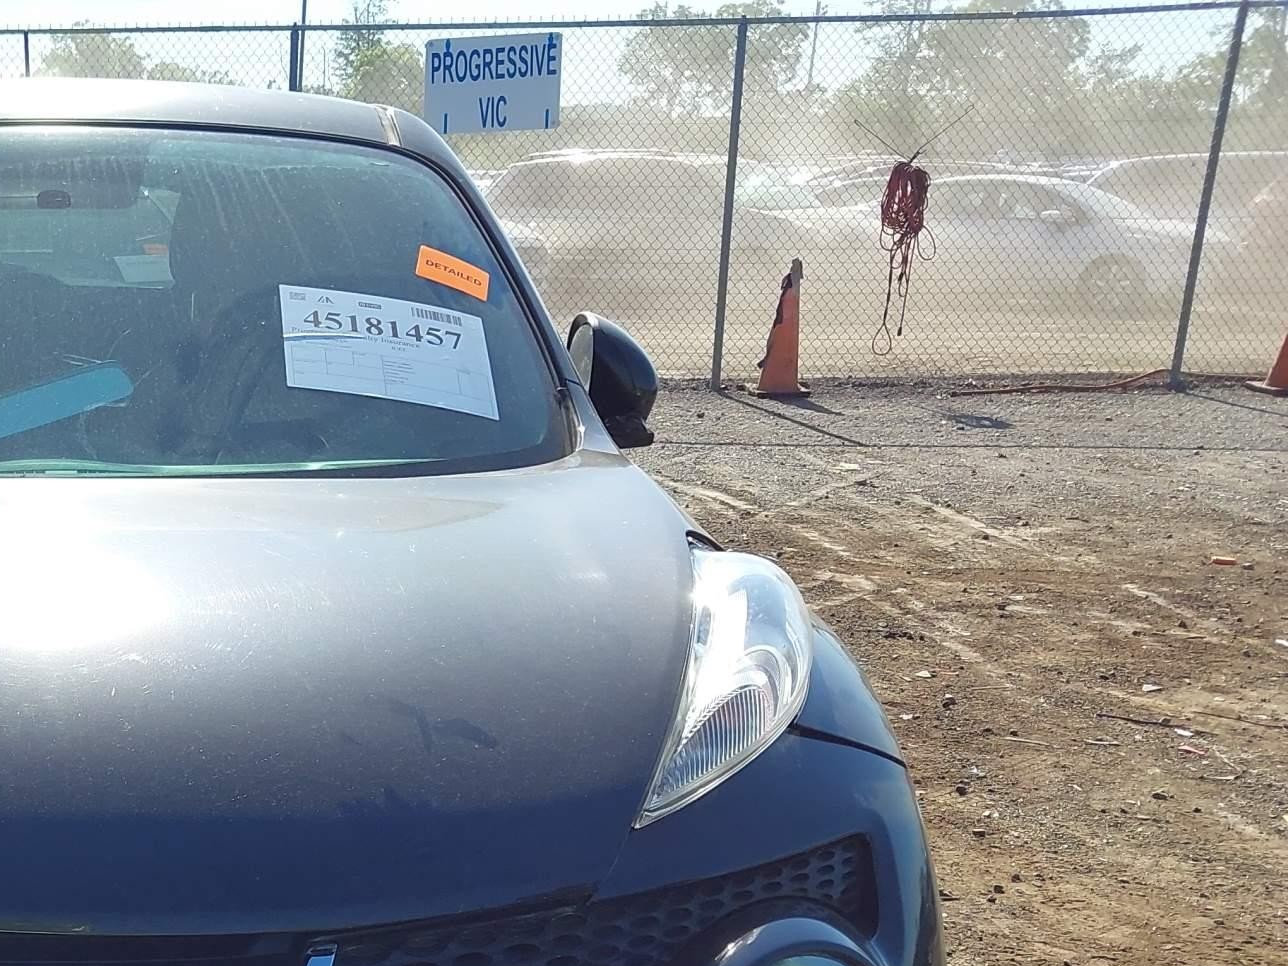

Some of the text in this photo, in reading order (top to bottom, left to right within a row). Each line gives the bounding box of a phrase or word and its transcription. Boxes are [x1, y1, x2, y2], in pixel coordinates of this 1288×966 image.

[431, 43, 557, 84] PROGRESSIVE
[479, 95, 508, 129] VIC
[425, 259, 482, 287] DETAILED
[303, 310, 462, 350] 45181457
